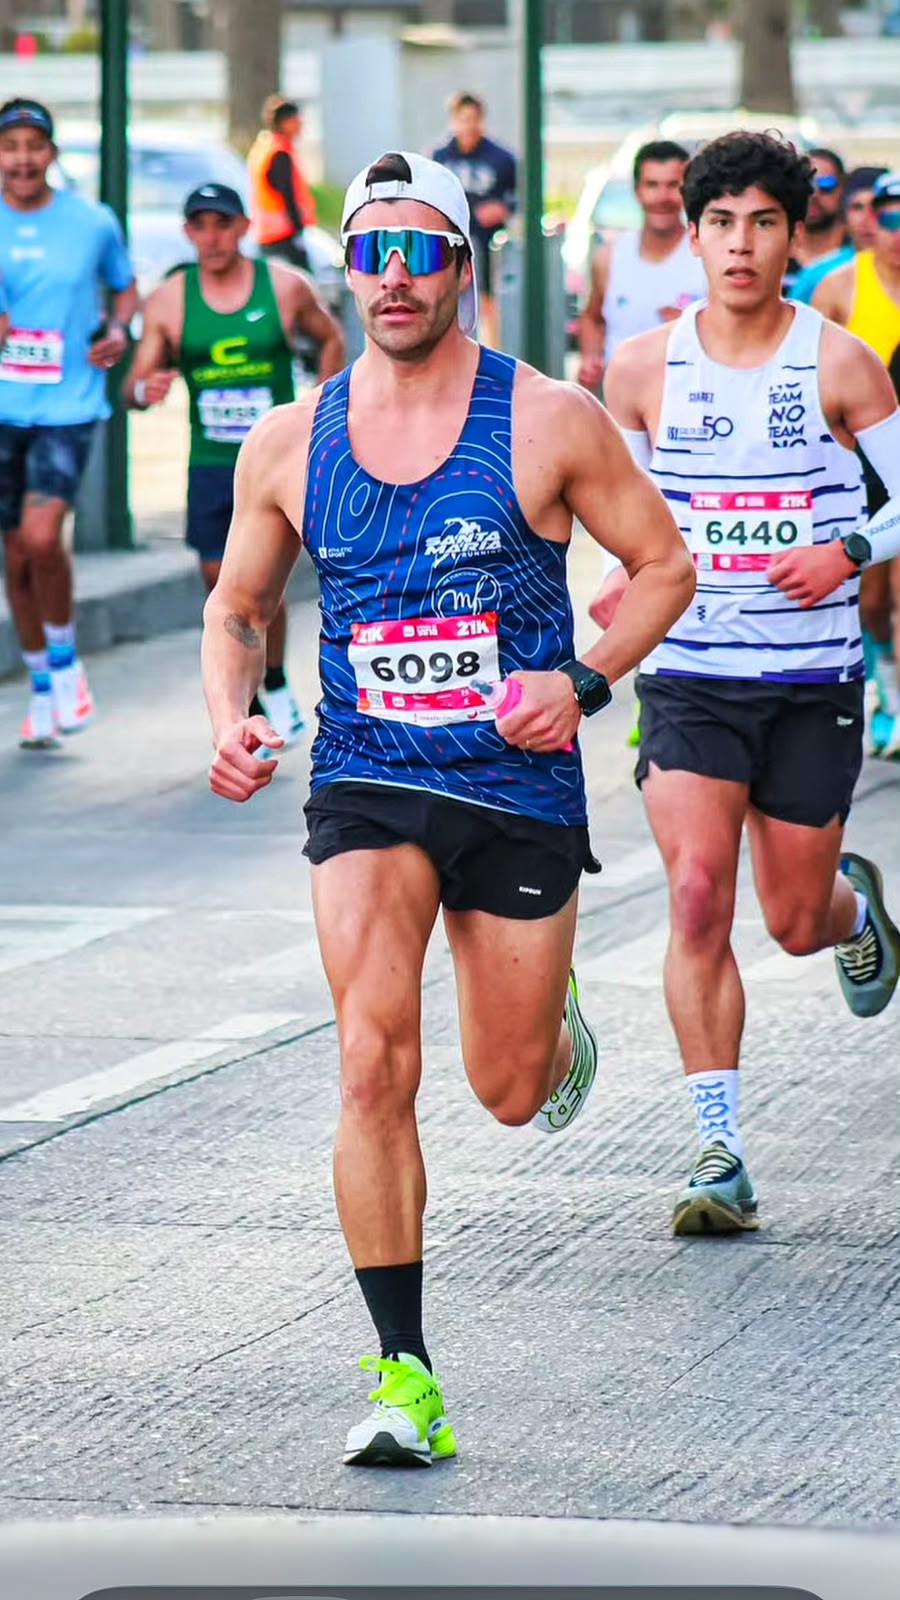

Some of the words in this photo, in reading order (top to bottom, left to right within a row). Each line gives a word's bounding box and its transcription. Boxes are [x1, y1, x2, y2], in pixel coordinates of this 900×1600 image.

[768, 390, 803, 404] TEAM
[769, 404, 805, 424] NO
[768, 424, 805, 439] TEAM
[426, 530, 501, 547] SANTA
[706, 520, 798, 545] 6440
[424, 539, 502, 556] MARIA
[457, 621, 489, 636] 21K
[370, 651, 480, 684] 6098
